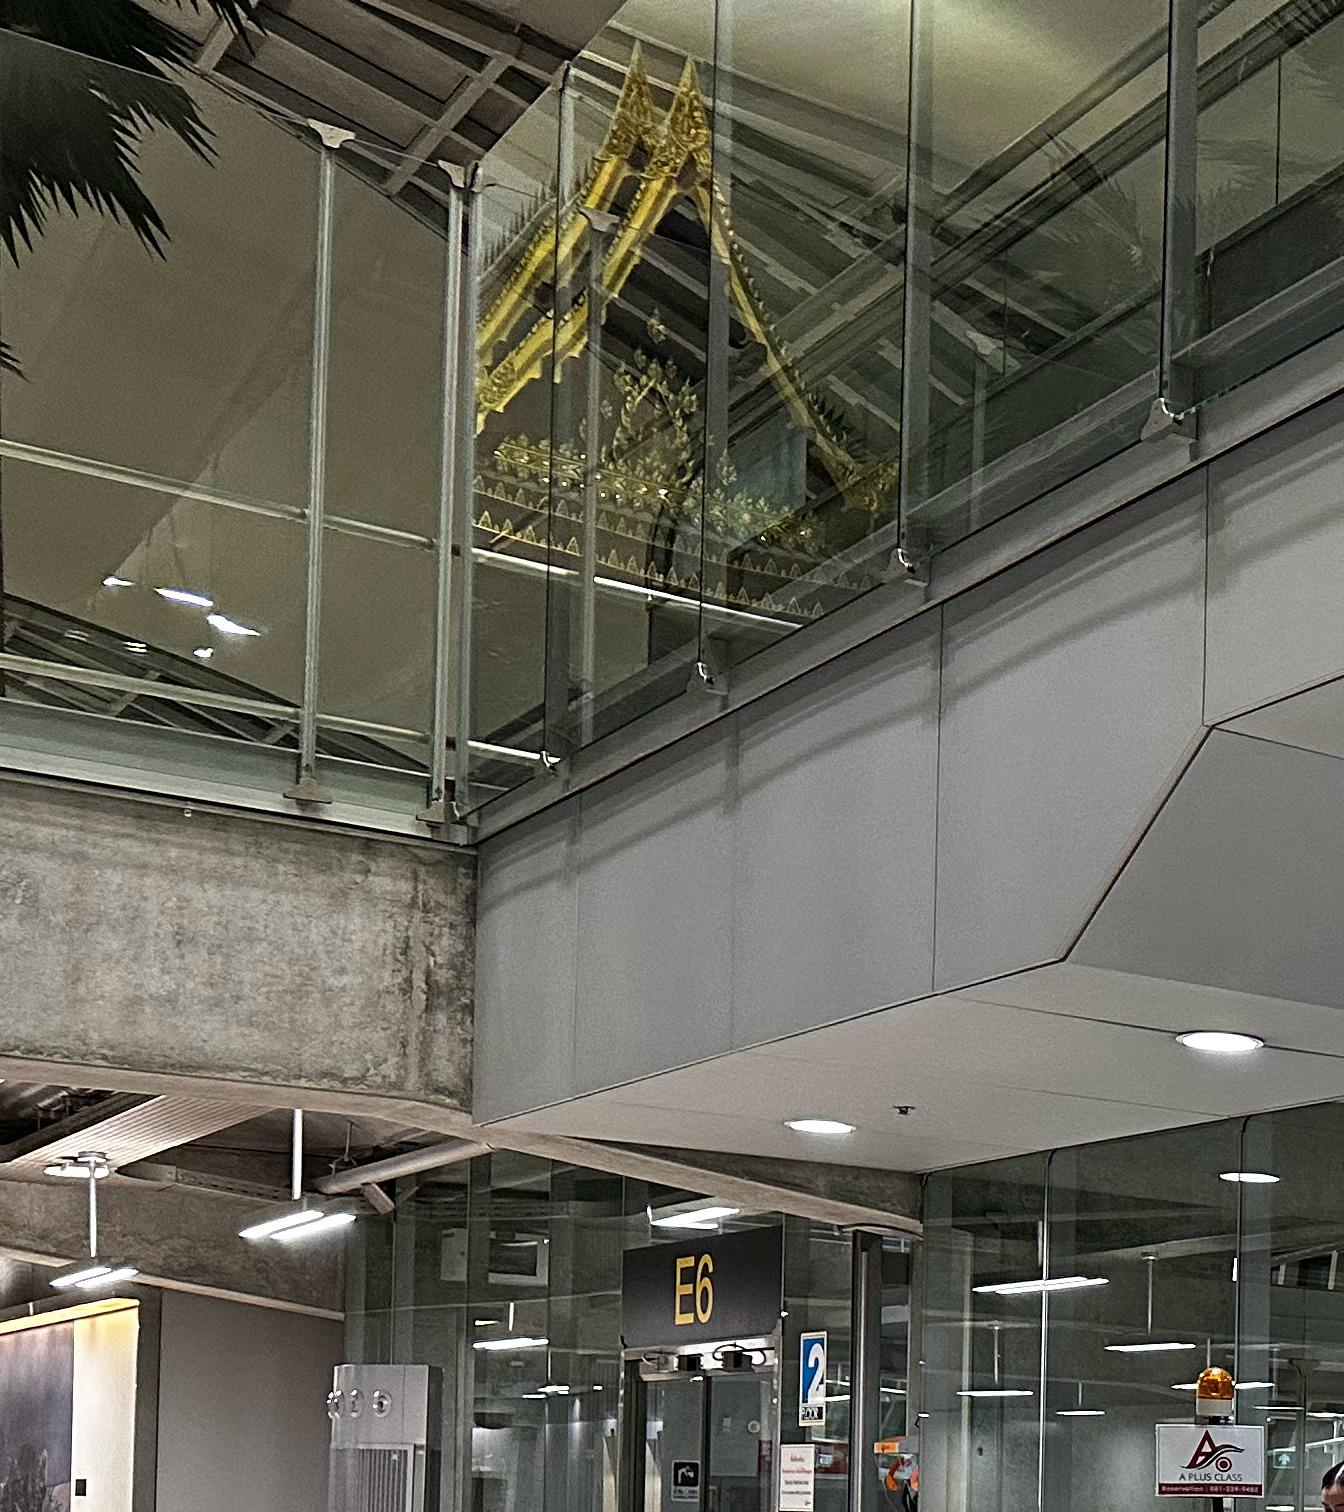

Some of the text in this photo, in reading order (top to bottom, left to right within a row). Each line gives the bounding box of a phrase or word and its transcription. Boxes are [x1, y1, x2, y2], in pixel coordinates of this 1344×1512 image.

[674, 1253, 713, 1326] E6
[806, 1342, 825, 1403] 2
[1188, 1473, 1212, 1482] PLUS
[1214, 1473, 1243, 1482] CLASS
